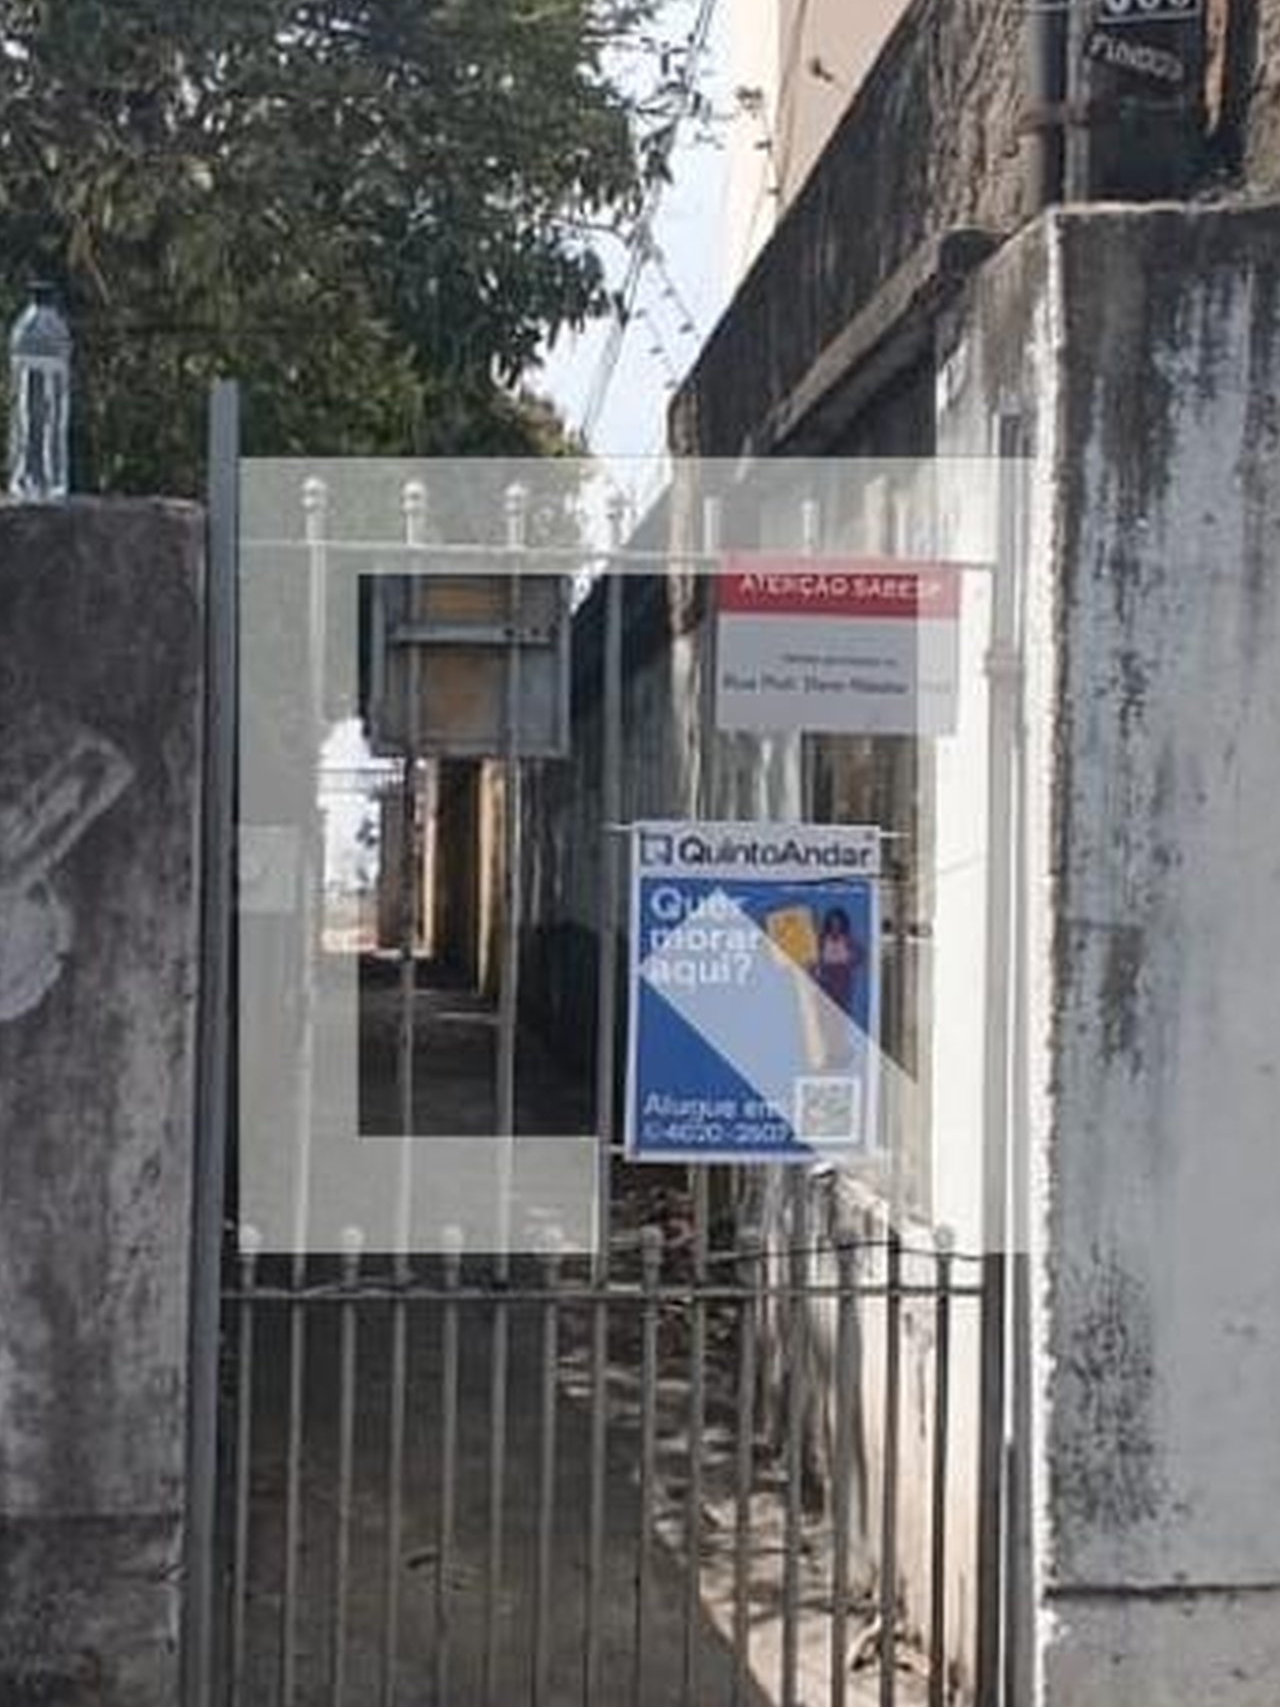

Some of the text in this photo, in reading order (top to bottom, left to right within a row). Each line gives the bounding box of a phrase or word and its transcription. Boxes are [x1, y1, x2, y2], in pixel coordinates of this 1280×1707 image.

[678, 835, 873, 867] QuintoAndar
[650, 928, 764, 951] morar
[648, 952, 753, 989] aqui?
